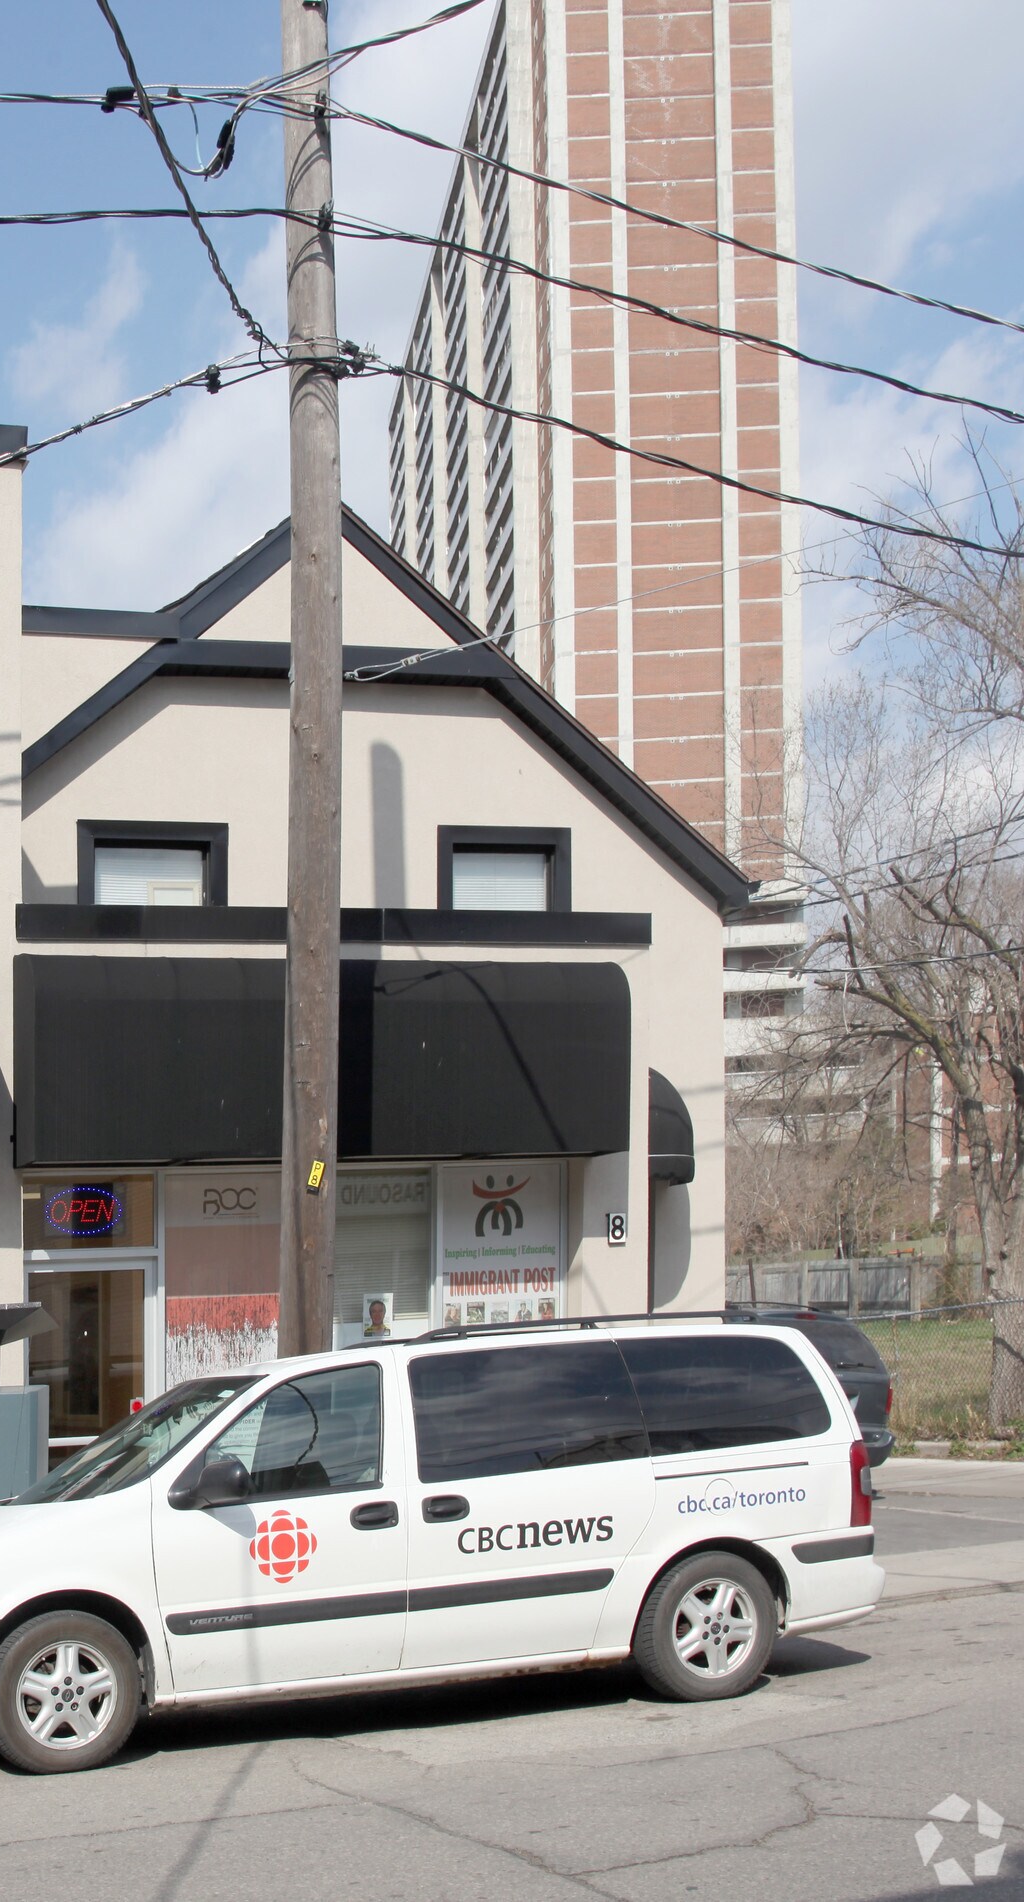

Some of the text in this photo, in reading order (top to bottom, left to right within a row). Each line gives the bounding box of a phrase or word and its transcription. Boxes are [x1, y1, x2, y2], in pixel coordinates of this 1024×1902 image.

[50, 1199, 115, 1223] OPEN
[611, 1215, 625, 1240] 8
[444, 1244, 556, 1259] Inspiring Informing Educating
[449, 1268, 521, 1296] IMMIGRANT
[523, 1267, 556, 1293] POST
[678, 1487, 806, 1514] cbc.ca/toronto
[189, 1613, 253, 1626] VENTURE
